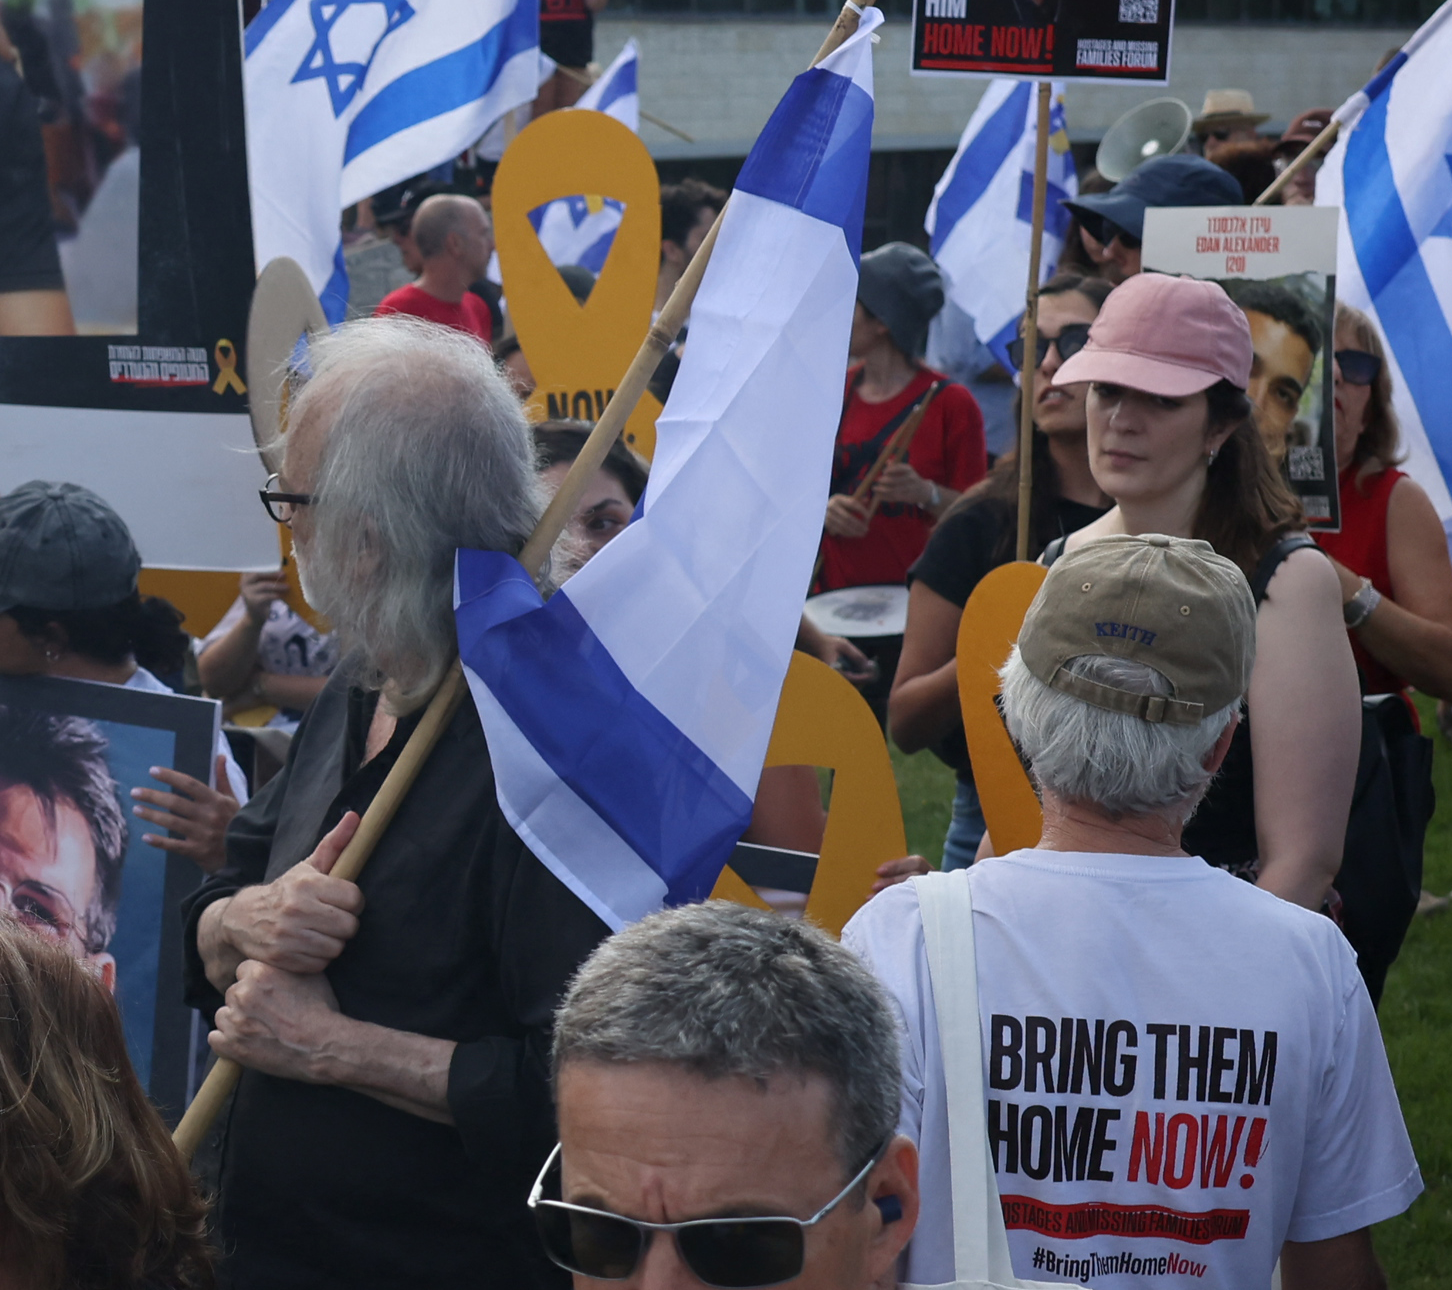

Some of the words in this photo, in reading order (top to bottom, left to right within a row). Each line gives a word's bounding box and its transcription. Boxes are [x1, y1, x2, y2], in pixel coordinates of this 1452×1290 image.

[923, 23, 986, 56] HOME
[991, 24, 1055, 60] NOW!
[1076, 49, 1120, 66] FAMILIES
[1121, 51, 1158, 68] FORUM
[1196, 236, 1220, 253] EDAN
[1223, 236, 1280, 253] ALEXANDER
[1095, 621, 1157, 646] KEITH
[989, 1013, 1137, 1098] BRING
[1146, 1023, 1277, 1106] THEM
[988, 1100, 1121, 1183] HOME
[1127, 1111, 1271, 1190] NOW!
[1002, 1202, 1063, 1233] OSTAGES
[1148, 1211, 1209, 1240] FAMILIES
[1032, 1247, 1207, 1283] #BringThemHomeNow
